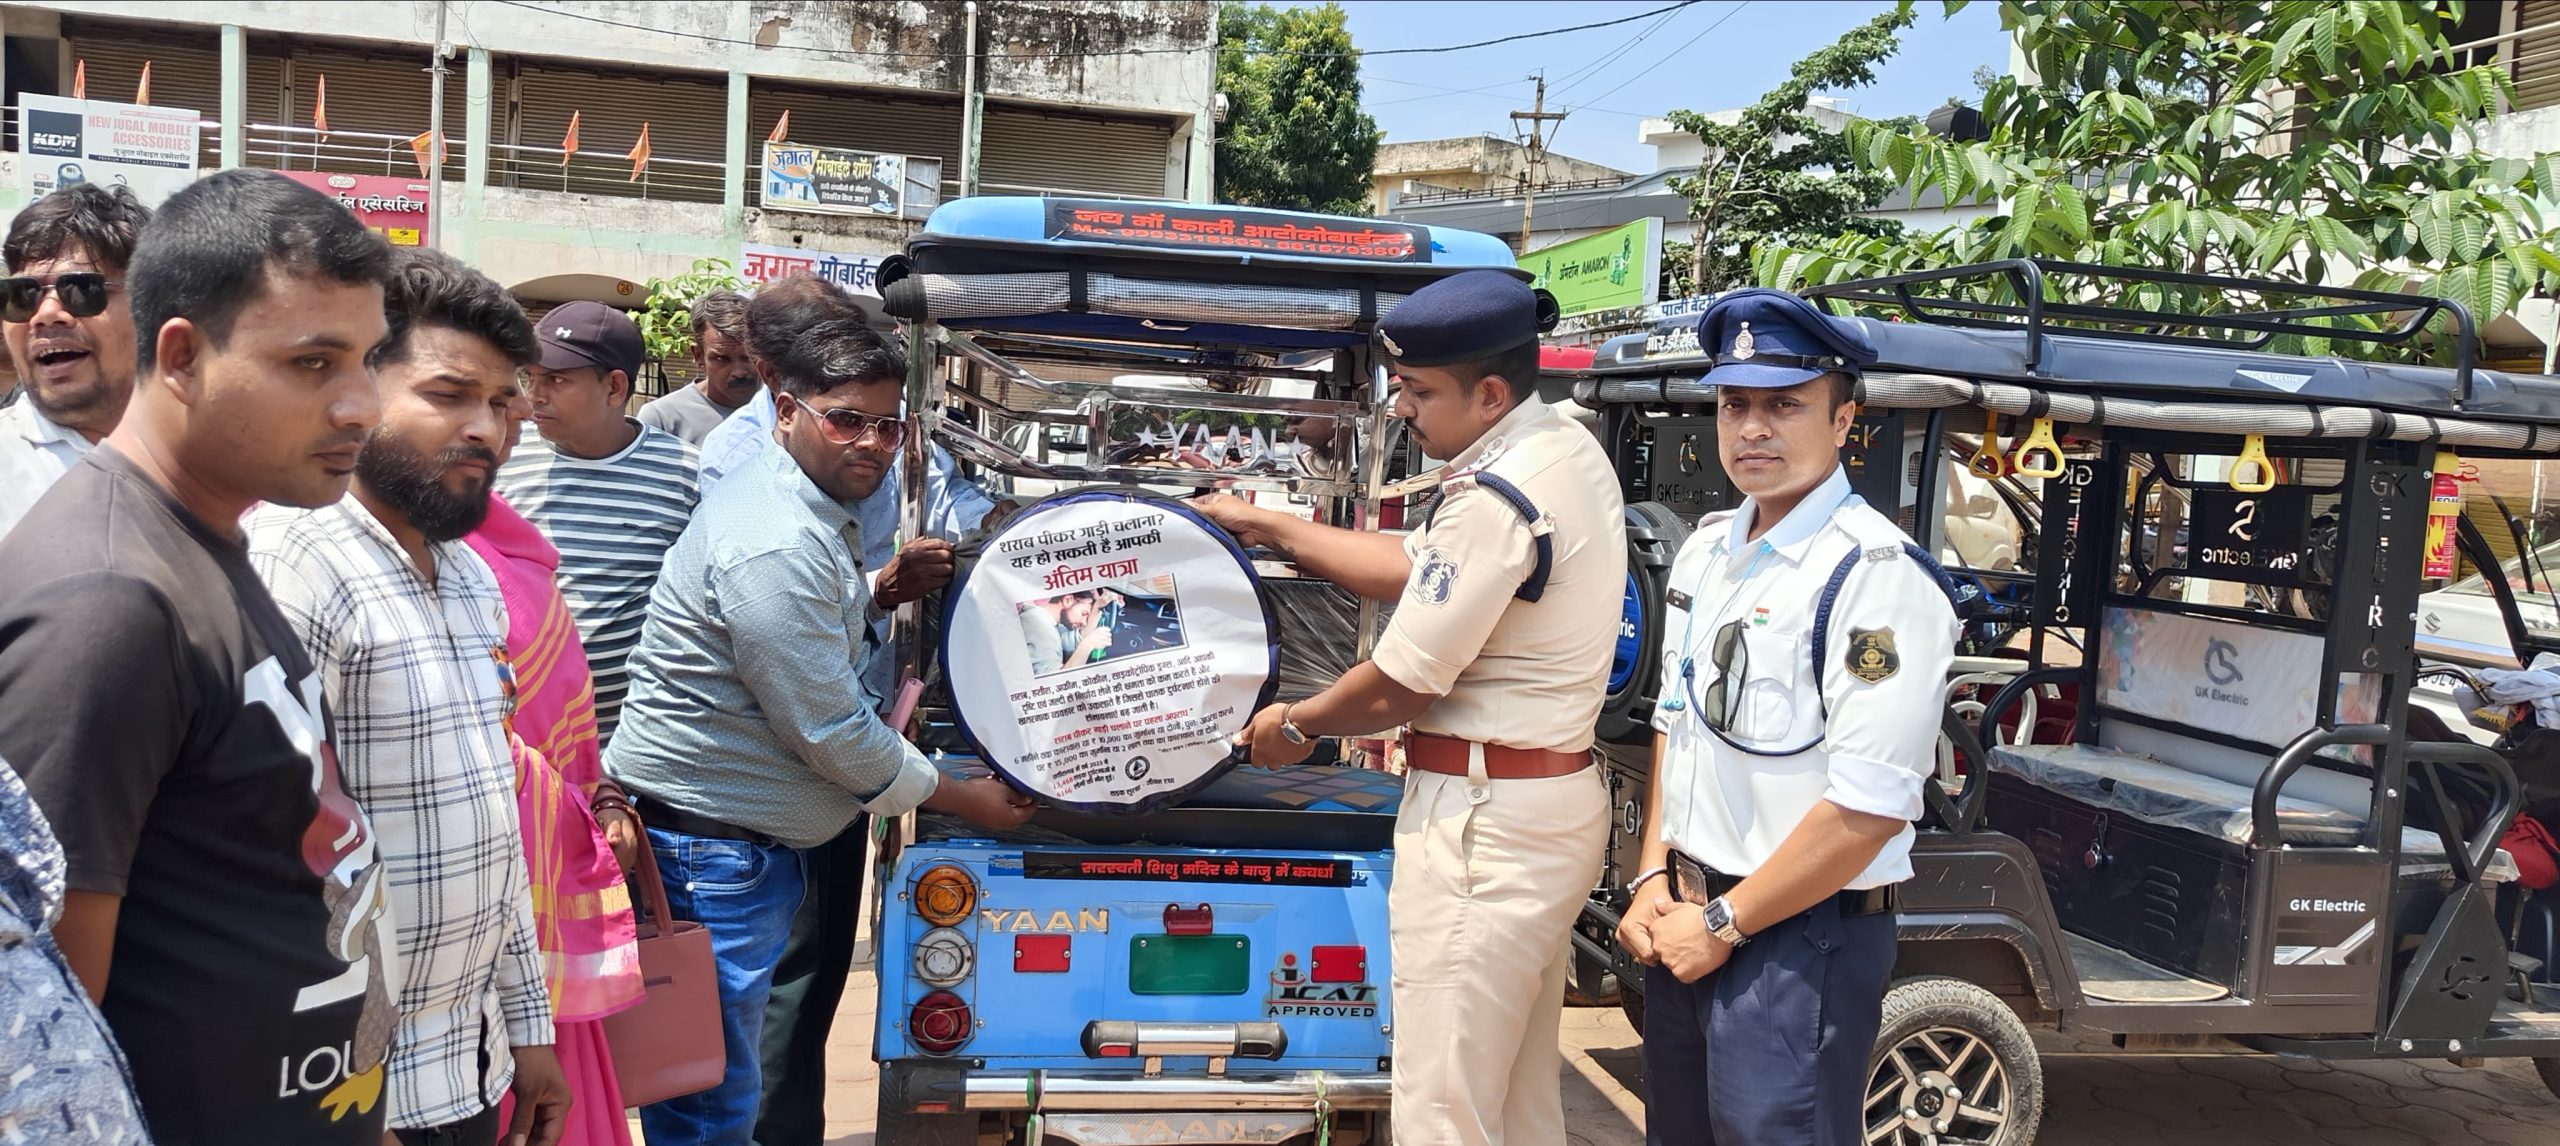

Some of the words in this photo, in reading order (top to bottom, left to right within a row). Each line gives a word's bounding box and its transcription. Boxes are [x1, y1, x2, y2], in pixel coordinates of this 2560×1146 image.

[88, 115, 111, 129] NEW
[113, 118, 145, 133] JUGAL
[148, 121, 192, 137] MOBILE
[33, 132, 77, 148] KDM
[113, 132, 192, 151] ACCESSORIES
[142, 159, 179, 168] ACCESSORIES
[772, 150, 812, 171] जुगल
[853, 156, 872, 180] शॉप
[360, 194, 426, 213] एसेसरिज
[1074, 210, 1125, 226] जय
[1170, 218, 1236, 236] काली
[1581, 255, 1610, 276] AMARON
[1661, 299, 1688, 316] पाली
[1165, 421, 1278, 460] YAAN
[2370, 470, 2408, 498] GK
[999, 536, 1034, 554] शराब
[1038, 530, 1077, 547] पीकर
[1078, 520, 1110, 539] गाड़ी
[1112, 513, 1164, 532] चलाना?
[1010, 555, 1033, 569] यह
[1035, 550, 1051, 568] हो
[1054, 540, 1098, 562] सकती
[1100, 538, 1111, 554] है
[1114, 529, 1162, 551] आपकी
[1043, 564, 1094, 591] अंतिम
[1096, 558, 1140, 580] यात्रा
[1010, 690, 1032, 702] शराब,
[1081, 674, 1111, 686] कोकीन,
[1177, 654, 1192, 666] आदि
[1193, 650, 1215, 662] आपकी
[1048, 694, 1066, 706] जल्दी
[1066, 692, 1075, 703] से
[1075, 690, 1097, 701] निर्णय
[1097, 684, 1112, 696] लेने
[1112, 684, 1122, 692] की
[1124, 679, 1146, 690] क्षमता
[1146, 675, 1156, 686] को
[1156, 674, 1172, 683] कम
[1172, 669, 1190, 680] करते
[1198, 664, 1210, 674] और
[1018, 713, 1050, 726] खतरनाक
[1050, 706, 1076, 719] व्यवहार
[1076, 702, 1087, 712] को
[1122, 691, 1144, 704] जिससे
[1145, 688, 1166, 698] घातक
[1196, 676, 1211, 688] होने
[1211, 674, 1221, 684] की
[1131, 702, 1149, 714] जाती
[2194, 686, 2208, 698] GK
[2212, 688, 2249, 706] Electric
[1053, 742, 1081, 756] कारावास
[1082, 739, 1090, 747] या
[1098, 734, 1120, 744] 10,000
[1122, 732, 1132, 741] का
[1156, 726, 1166, 734] या
[1218, 706, 1234, 718] करने
[1054, 736, 1072, 744] शराब
[1073, 728, 1092, 738] पीकर
[1110, 722, 1132, 732] चलाने
[1132, 720, 1142, 728] पर
[1144, 714, 1164, 726] पहला
[1164, 708, 1188, 722] अपराध
[1036, 764, 1046, 772] पर
[1054, 754, 1078, 766] 15,000
[1078, 750, 1088, 758] का
[1156, 736, 1166, 744] का
[1167, 730, 1195, 742] कारावास
[1196, 728, 1204, 736] या
[1081, 858, 1142, 875] सरस्वती
[1146, 858, 1179, 880] शिशु
[1182, 860, 1220, 877] मंदिर
[1224, 860, 1240, 876] के
[1242, 864, 1272, 882] बाजु
[1275, 862, 1290, 878] में
[1292, 864, 1334, 879] कवर्धा
[2290, 898, 2310, 912] GK
[2314, 898, 2366, 912] Electric
[981, 908, 1108, 932] YAAN
[1268, 1006, 1375, 1017] APPROVED
[1126, 1118, 1246, 1141] YAAN
